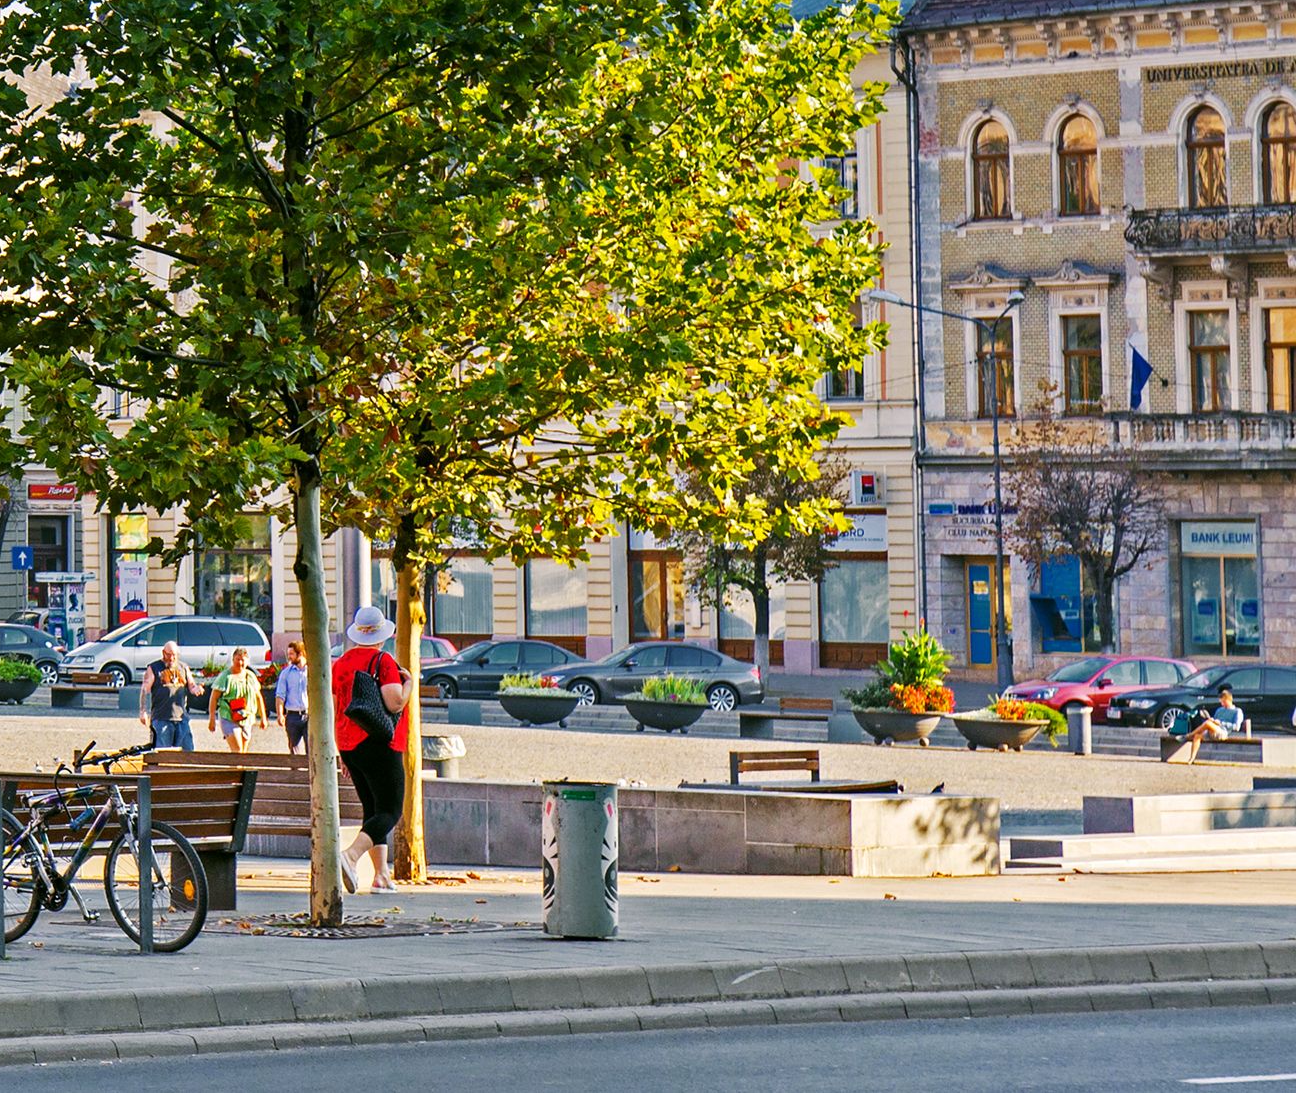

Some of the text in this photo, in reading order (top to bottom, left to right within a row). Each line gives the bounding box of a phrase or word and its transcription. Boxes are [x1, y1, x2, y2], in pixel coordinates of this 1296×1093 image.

[1147, 62, 1258, 82] UNIVERSITATEA
[1265, 60, 1285, 74] DE
[958, 505, 986, 515] BANK
[1191, 532, 1254, 543] BANK LEUMI
